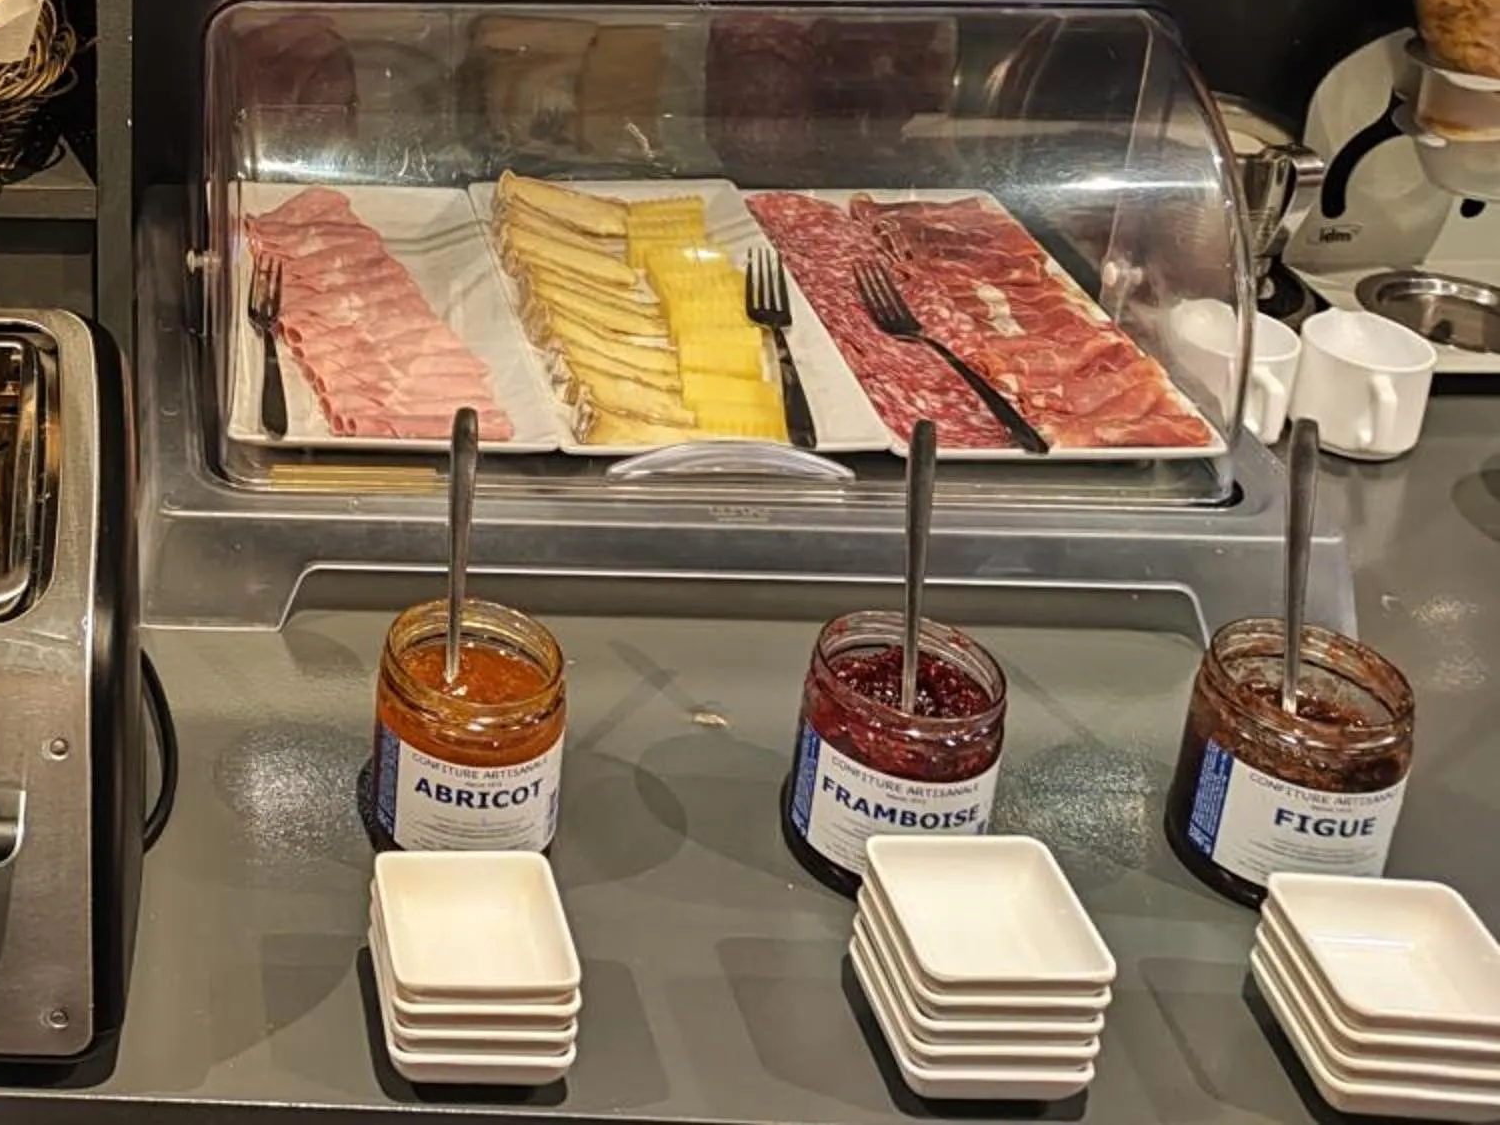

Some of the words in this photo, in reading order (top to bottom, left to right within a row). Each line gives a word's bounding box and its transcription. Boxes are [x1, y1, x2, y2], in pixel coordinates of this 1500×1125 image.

[831, 756, 901, 794] CONFITURE
[1250, 773, 1329, 804] CONFITURE
[414, 777, 544, 810] ABRICOT
[822, 776, 981, 830] FRAMBOISE
[1274, 806, 1377, 838] FIGUE
